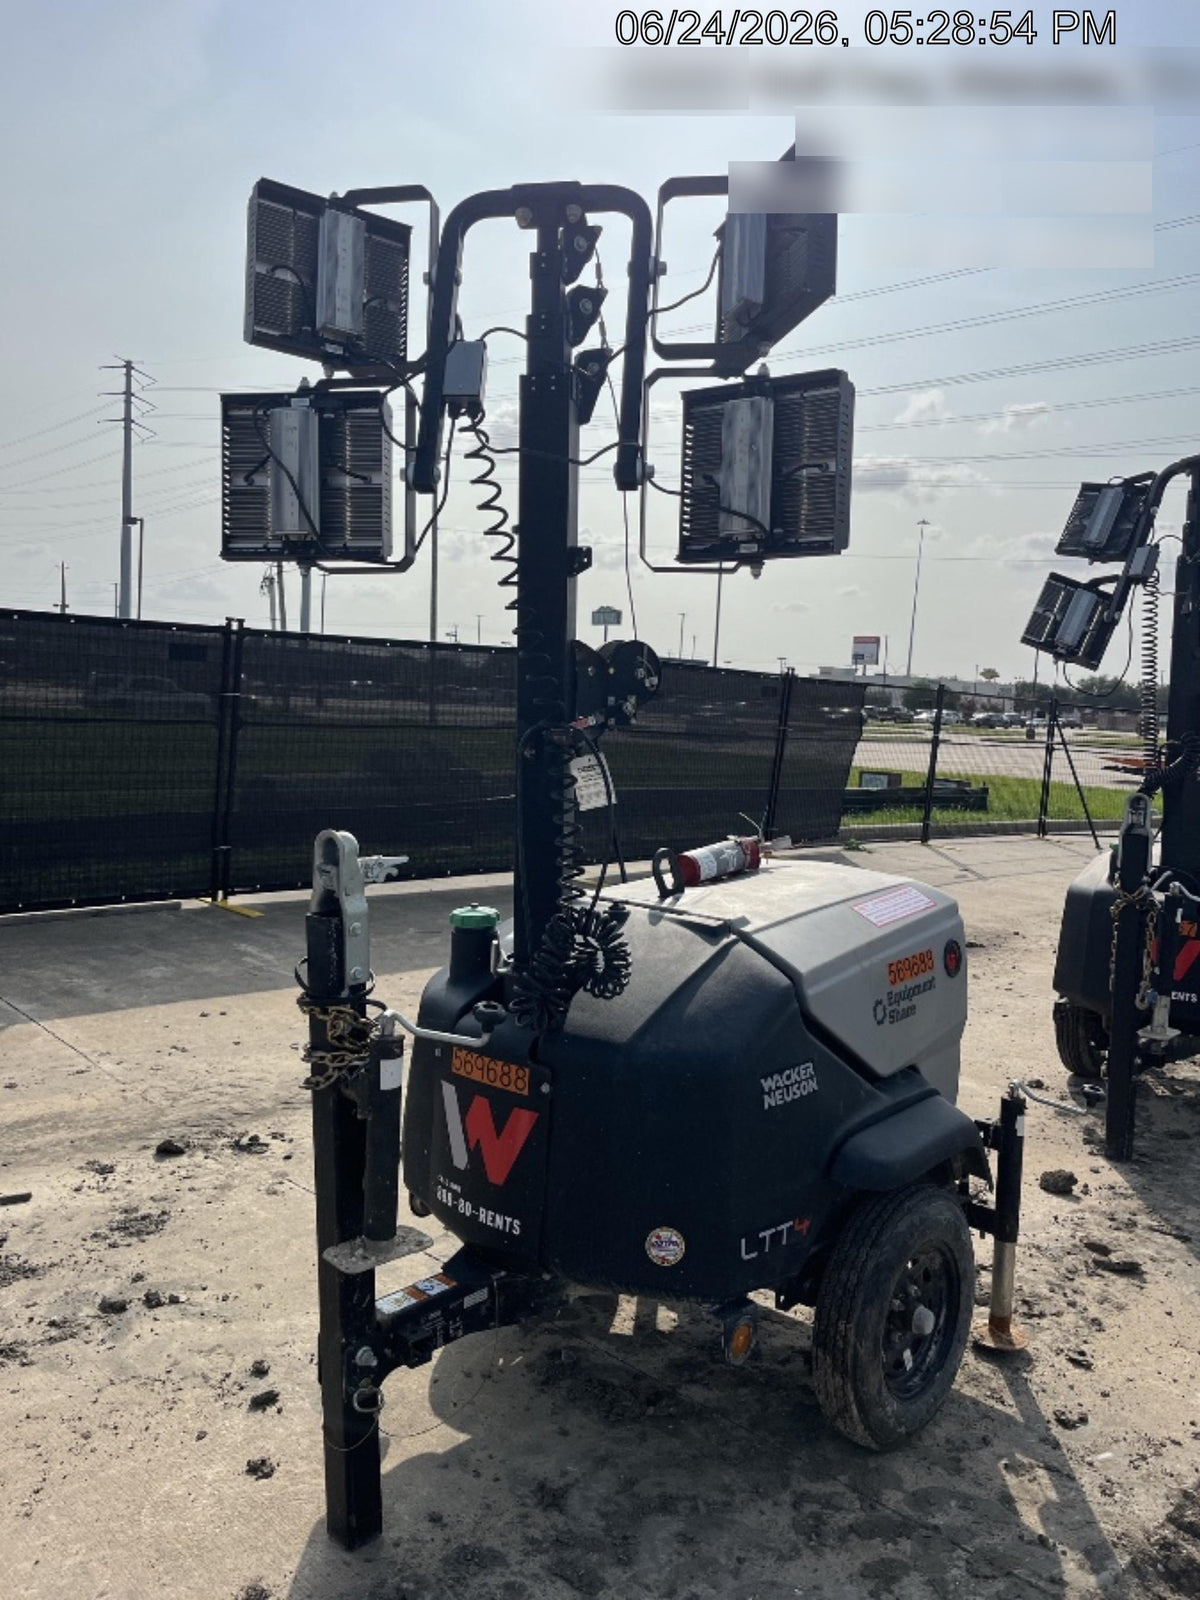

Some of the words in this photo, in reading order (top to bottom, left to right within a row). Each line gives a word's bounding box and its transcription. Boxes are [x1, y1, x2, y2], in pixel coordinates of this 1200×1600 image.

[452, 1049, 529, 1093] 569688
[760, 1062, 815, 1092] WACKER
[763, 1078, 818, 1110] NEUSON
[740, 1216, 811, 1261] LTT4
